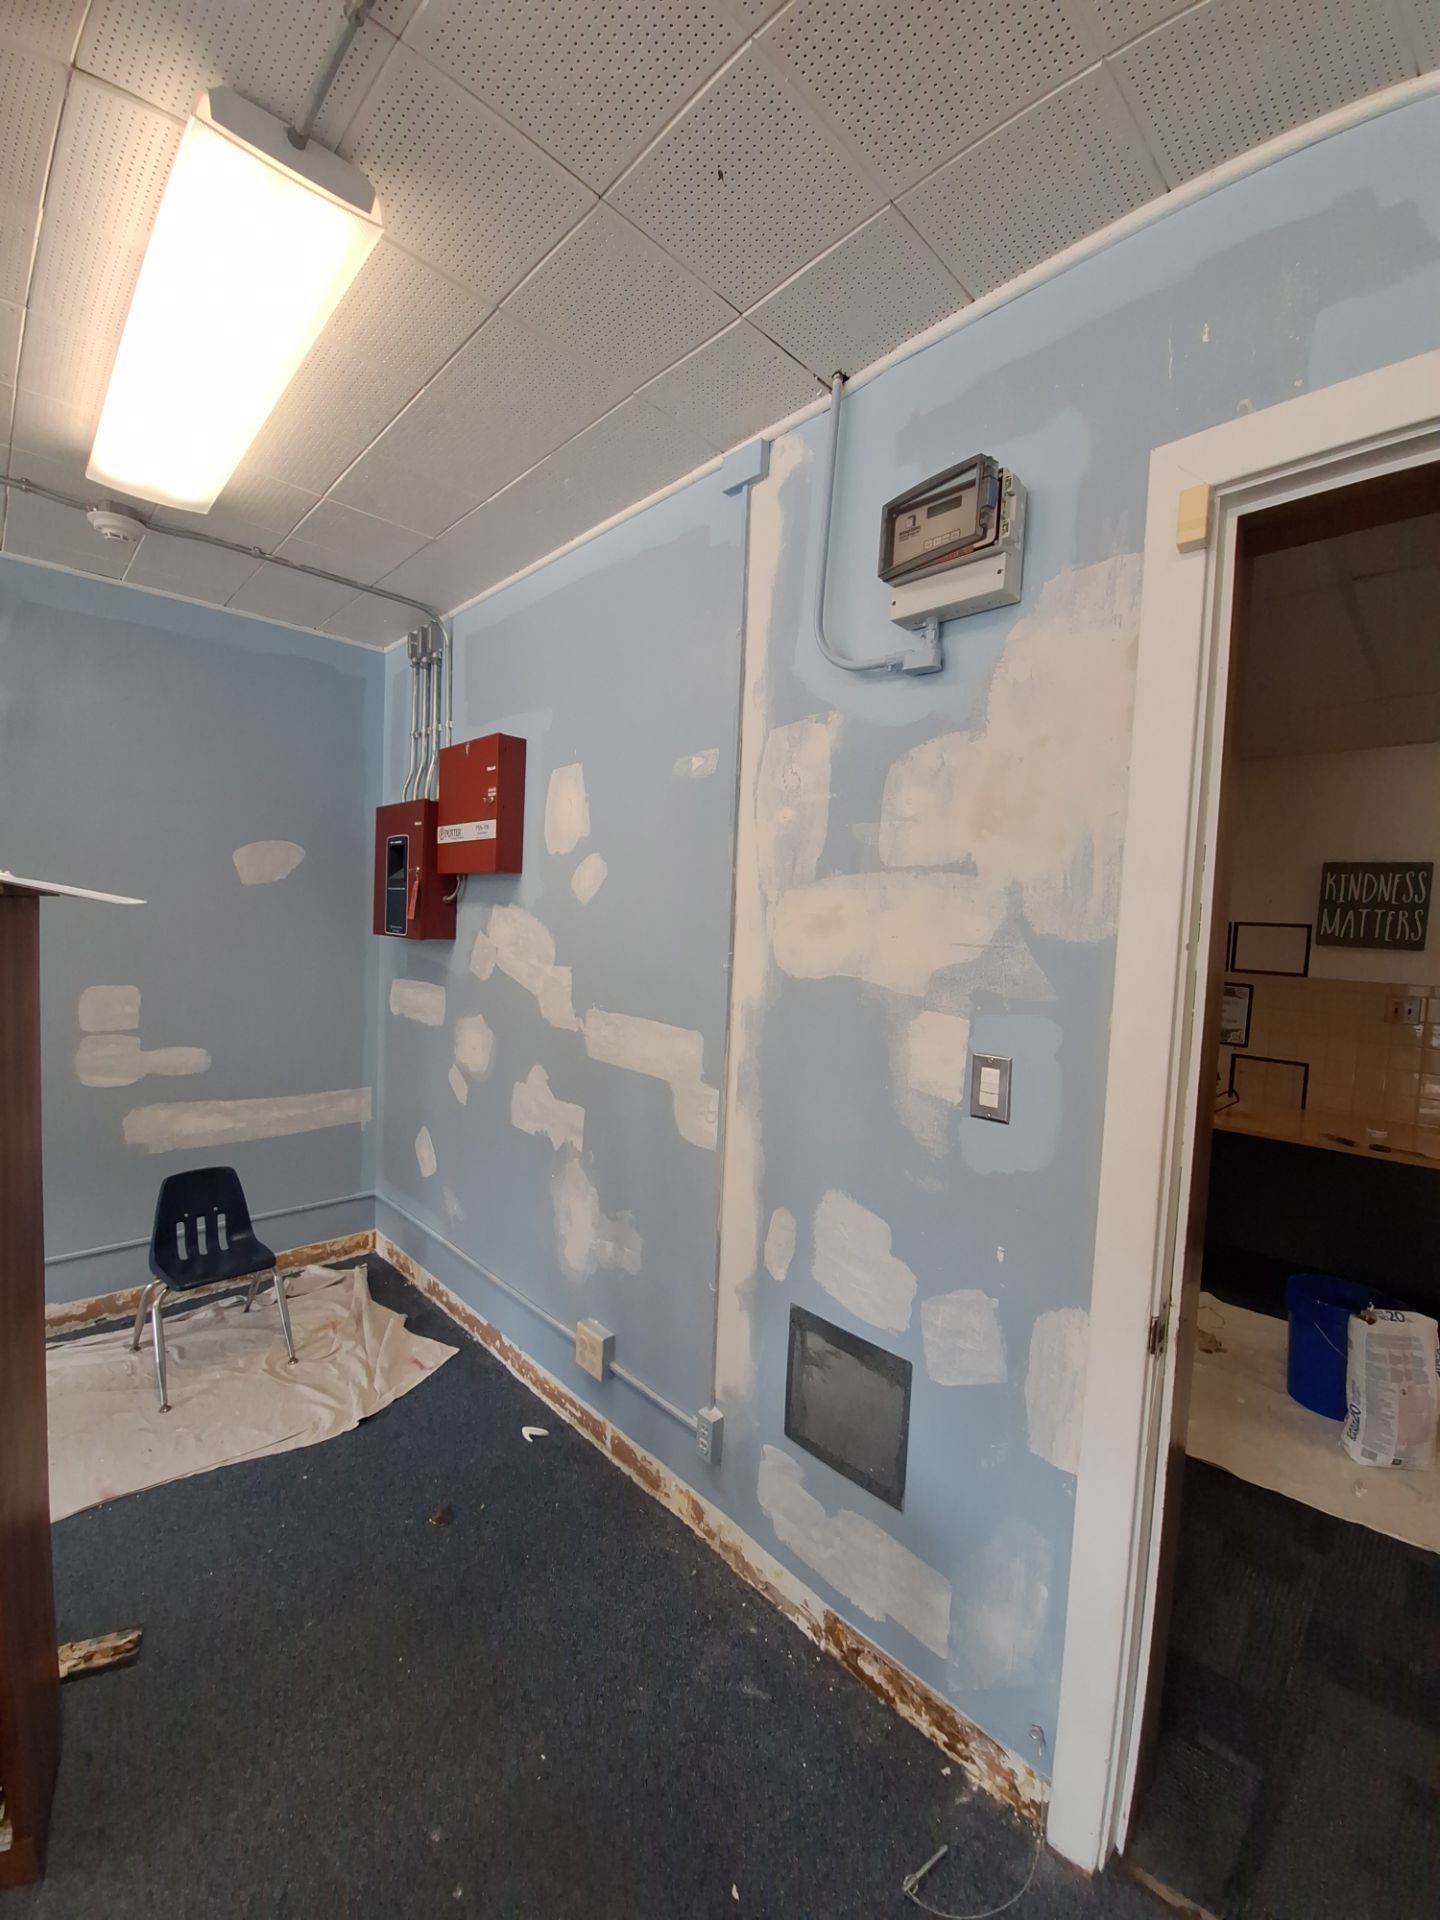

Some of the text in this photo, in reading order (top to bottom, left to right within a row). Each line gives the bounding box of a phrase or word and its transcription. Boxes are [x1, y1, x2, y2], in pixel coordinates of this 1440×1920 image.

[1324, 871, 1428, 904] KINDNESS
[1320, 908, 1424, 942] MATTERS
[1388, 1311, 1405, 1323] 20
